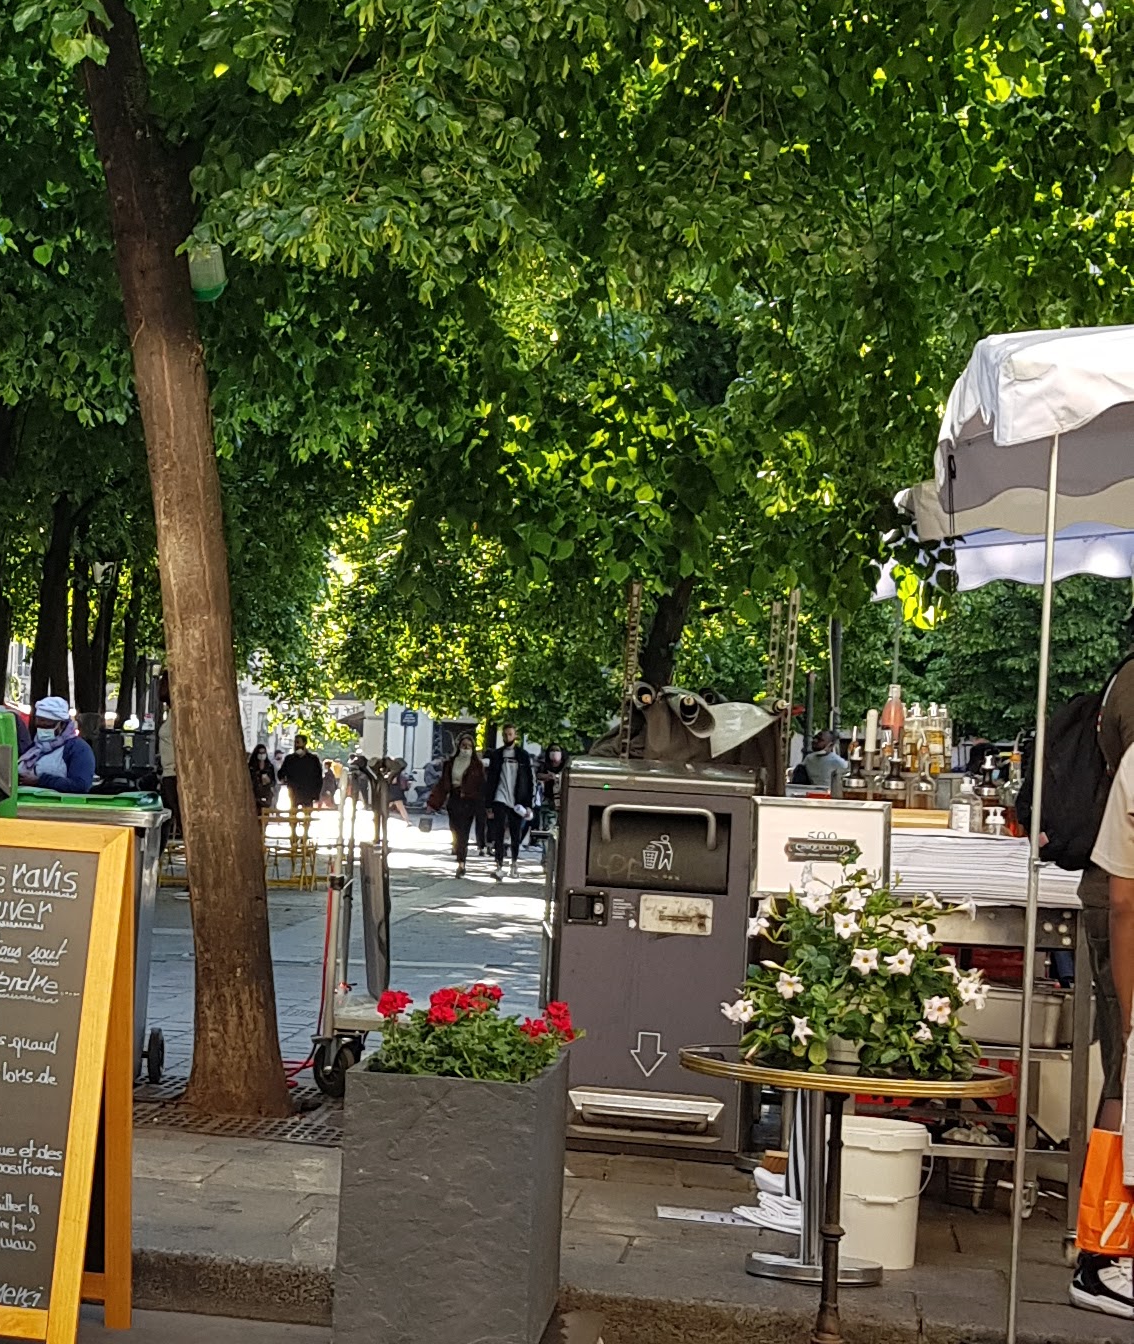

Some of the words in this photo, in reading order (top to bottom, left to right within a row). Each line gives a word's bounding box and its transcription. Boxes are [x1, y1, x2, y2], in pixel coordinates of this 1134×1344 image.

[11, 860, 79, 893] ravis
[2, 1061, 34, 1083] lors
[35, 1065, 58, 1086] de
[18, 1139, 37, 1158] et
[36, 1144, 64, 1161] des
[28, 1193, 41, 1215] la
